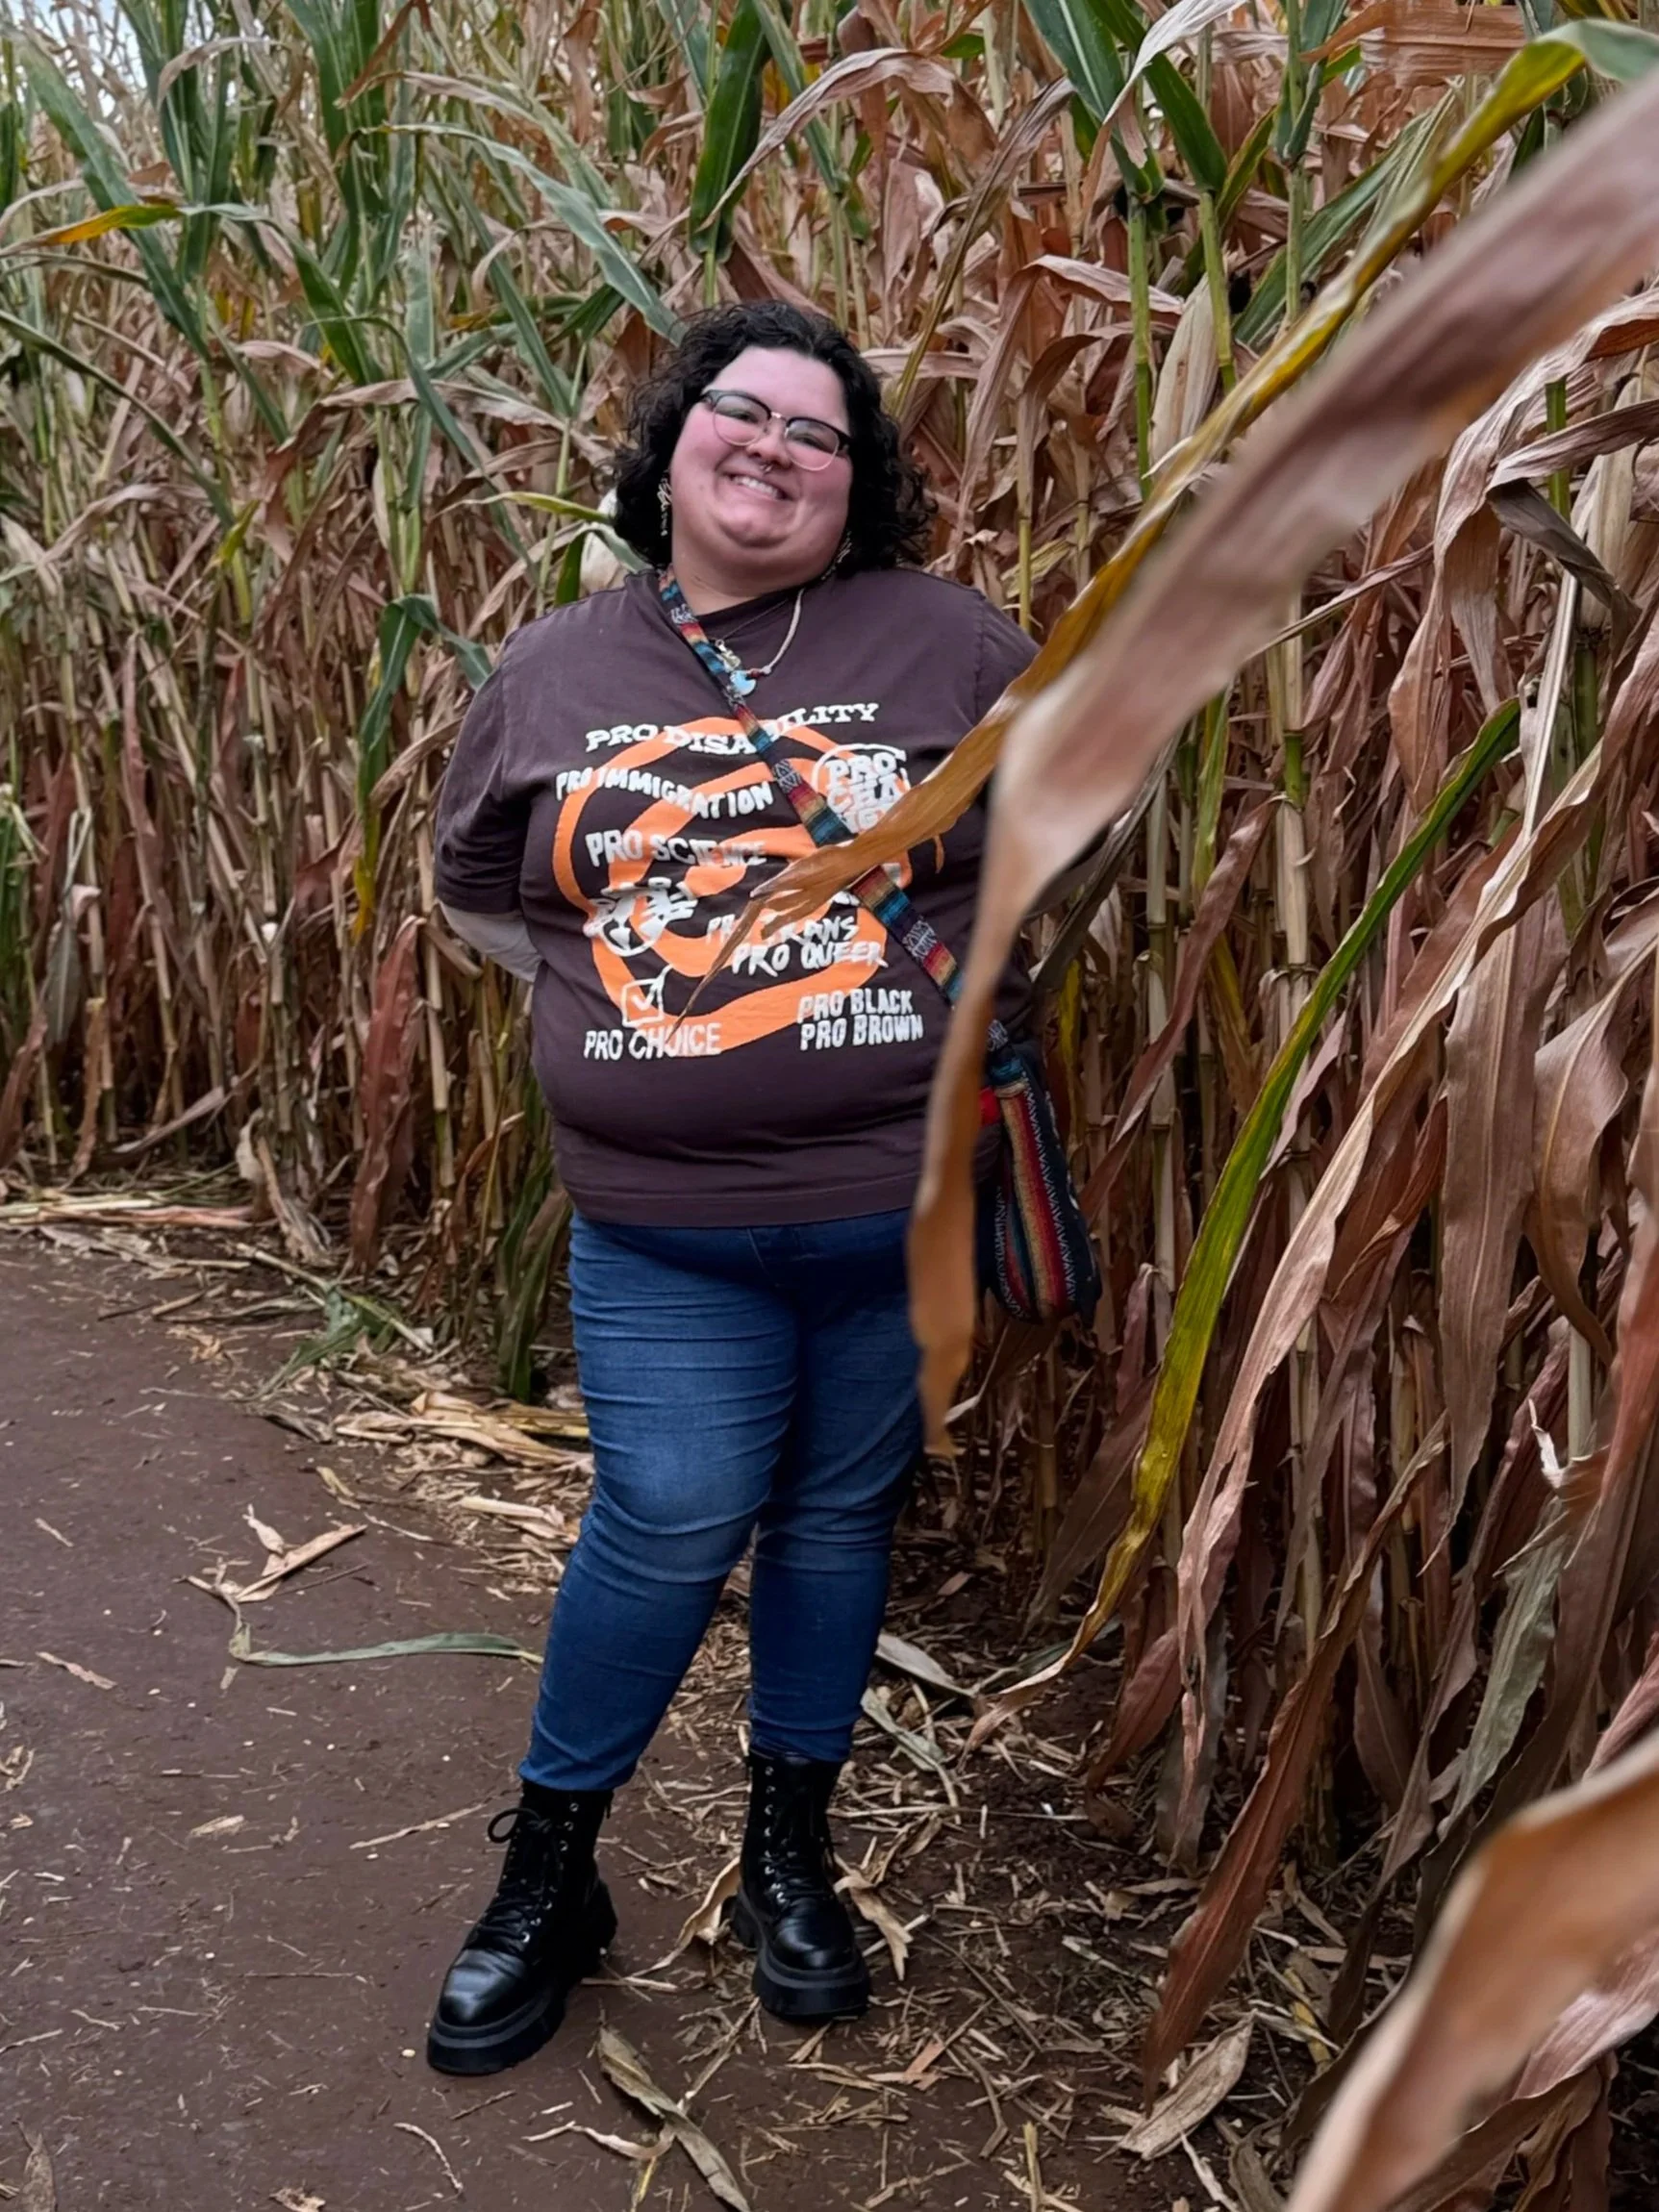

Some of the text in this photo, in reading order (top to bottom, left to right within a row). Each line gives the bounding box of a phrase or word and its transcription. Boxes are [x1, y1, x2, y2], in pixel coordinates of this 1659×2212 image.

[586, 724, 658, 752] PRO
[825, 751, 896, 790] PRO
[556, 767, 773, 818] PRO IMMIGRATION
[585, 829, 643, 867] PRO
[732, 941, 889, 977] PRO QUEER
[796, 988, 914, 1024] PRO BLACK
[583, 1022, 722, 1061] PRO CHOICE
[800, 1014, 923, 1051] PRO BROWN
